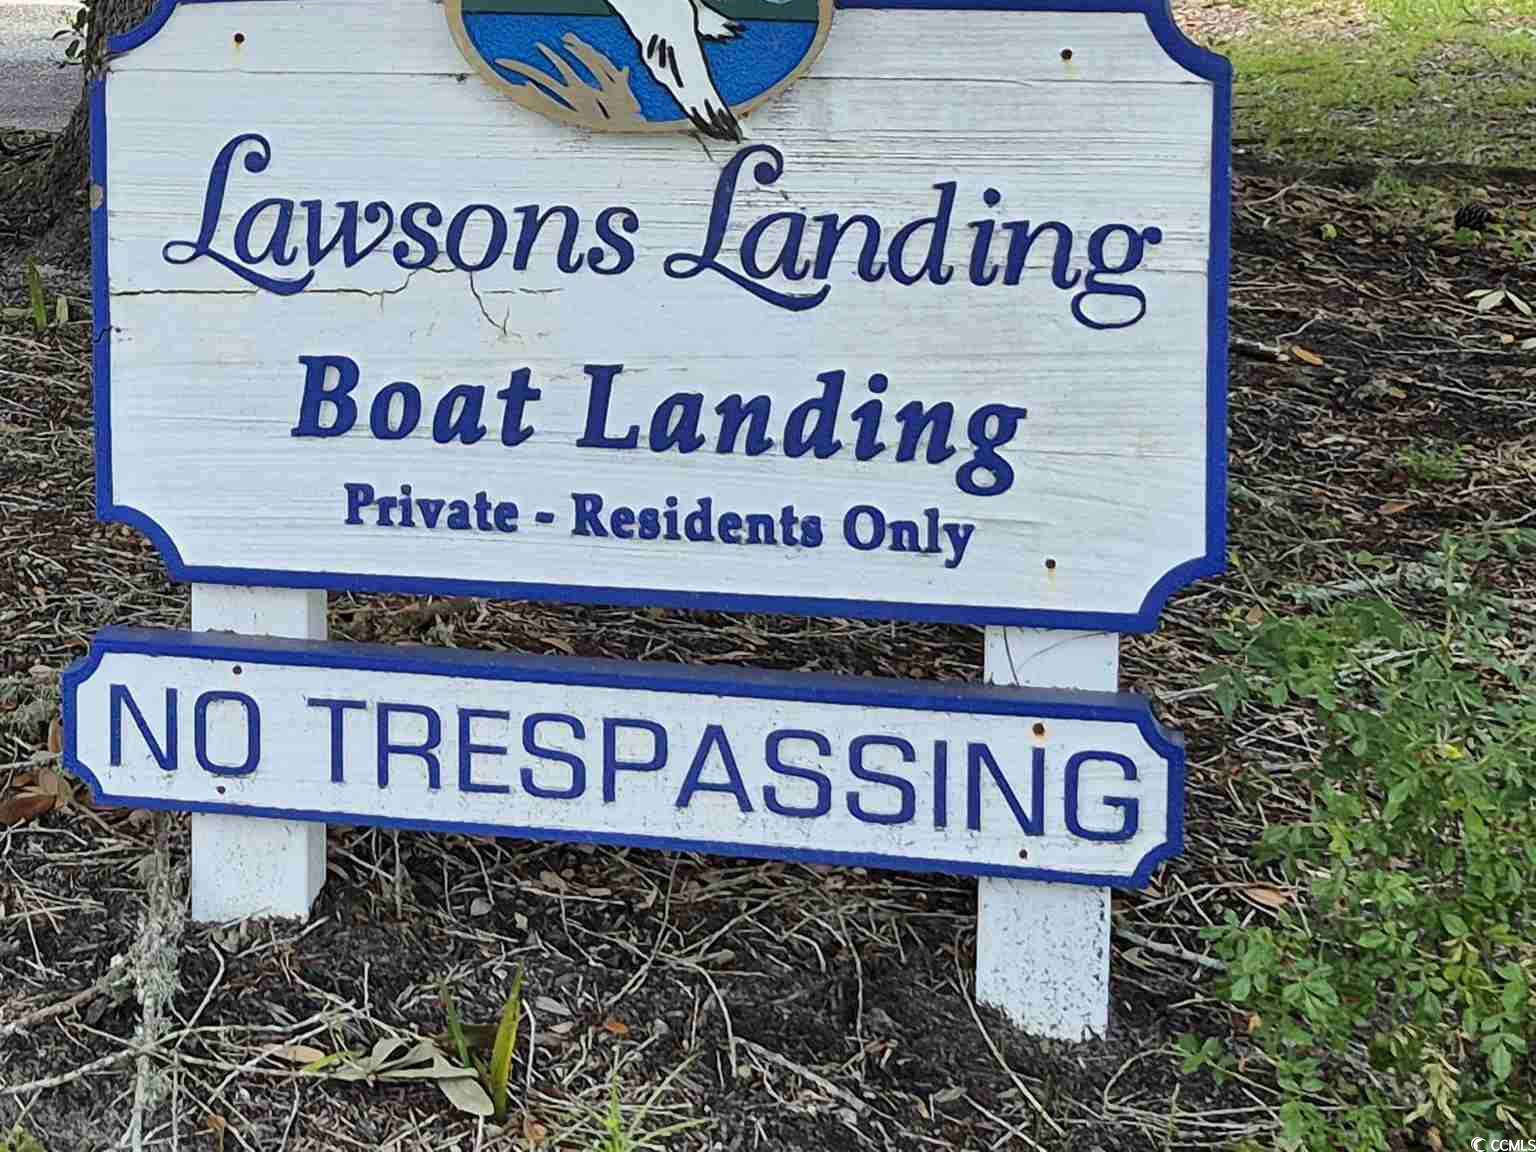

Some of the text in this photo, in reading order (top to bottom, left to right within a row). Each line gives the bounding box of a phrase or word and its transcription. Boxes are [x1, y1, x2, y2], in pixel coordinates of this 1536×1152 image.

[161, 132, 1164, 332] Lawsons Landing
[289, 354, 1027, 498] Boat Landing
[342, 481, 977, 570] Private - Residents Only
[108, 682, 1142, 846] NO TRESPASSING
